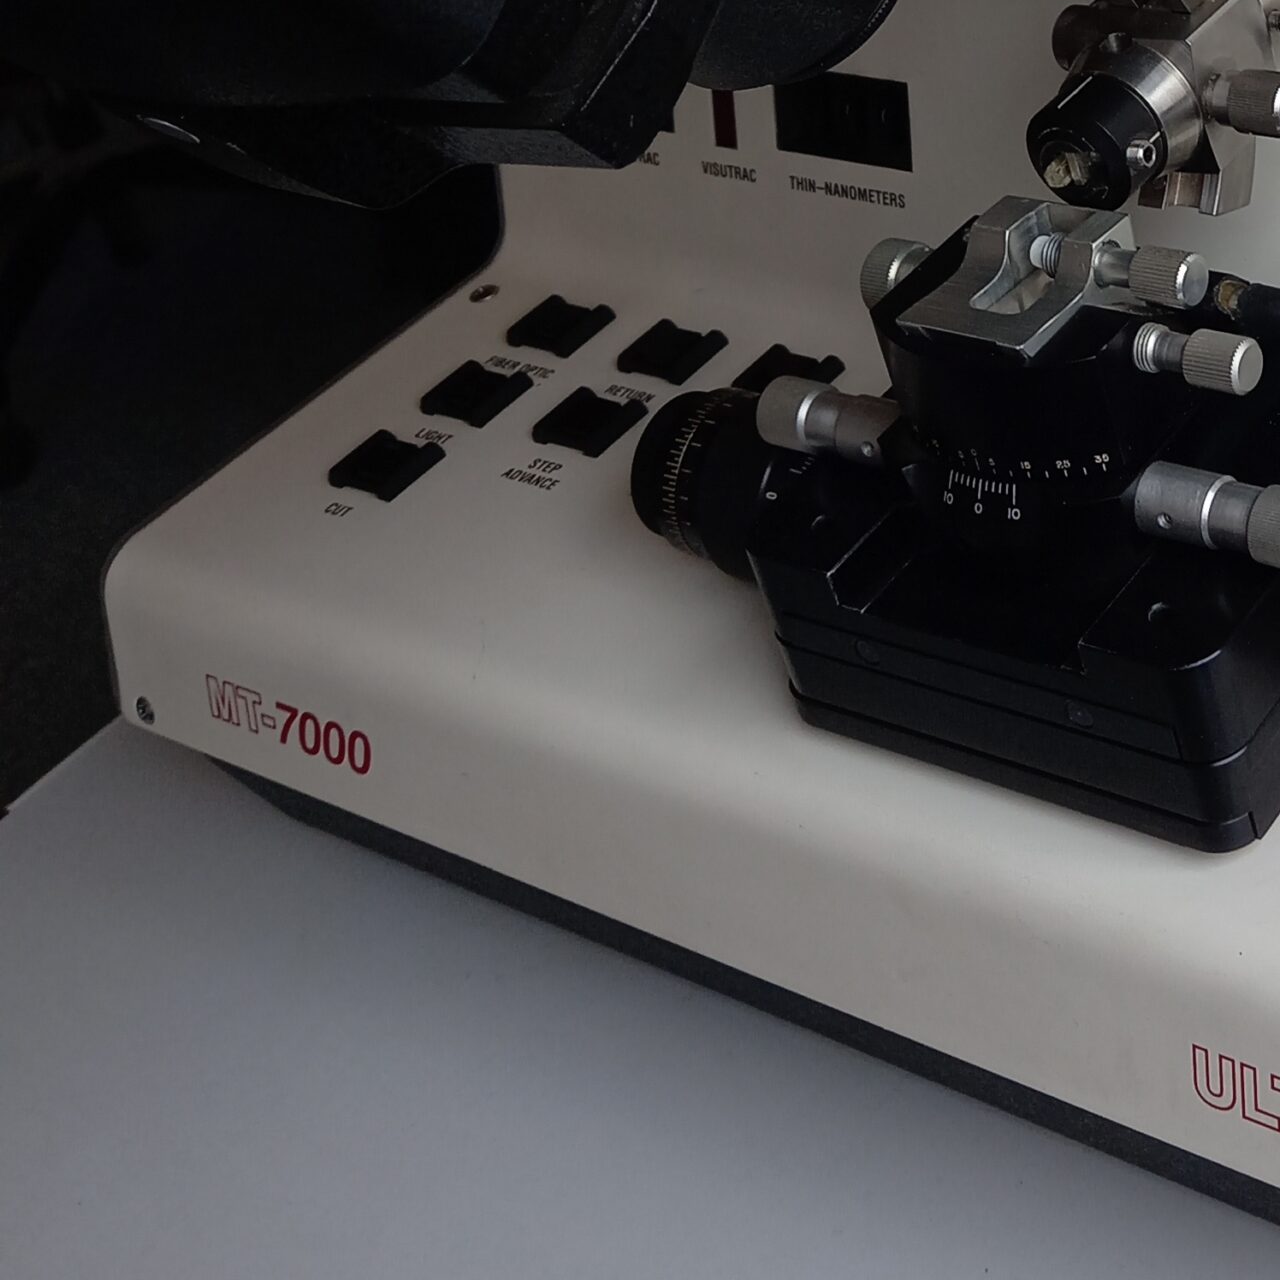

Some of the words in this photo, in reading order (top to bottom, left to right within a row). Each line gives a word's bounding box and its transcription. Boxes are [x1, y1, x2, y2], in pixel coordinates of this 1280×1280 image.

[701, 161, 757, 183] VISUTRAC
[789, 175, 906, 209] THIN-NANOMETERS
[485, 355, 521, 371] FIBER
[519, 363, 555, 380] OPTIC
[604, 383, 656, 404] RETURN
[414, 427, 454, 445] LIGHT
[528, 458, 563, 472] STEP
[501, 467, 561, 491] ADVANCE
[324, 502, 354, 519] CUT
[1007, 507, 1021, 521] 10
[205, 673, 372, 775] MT-7000
